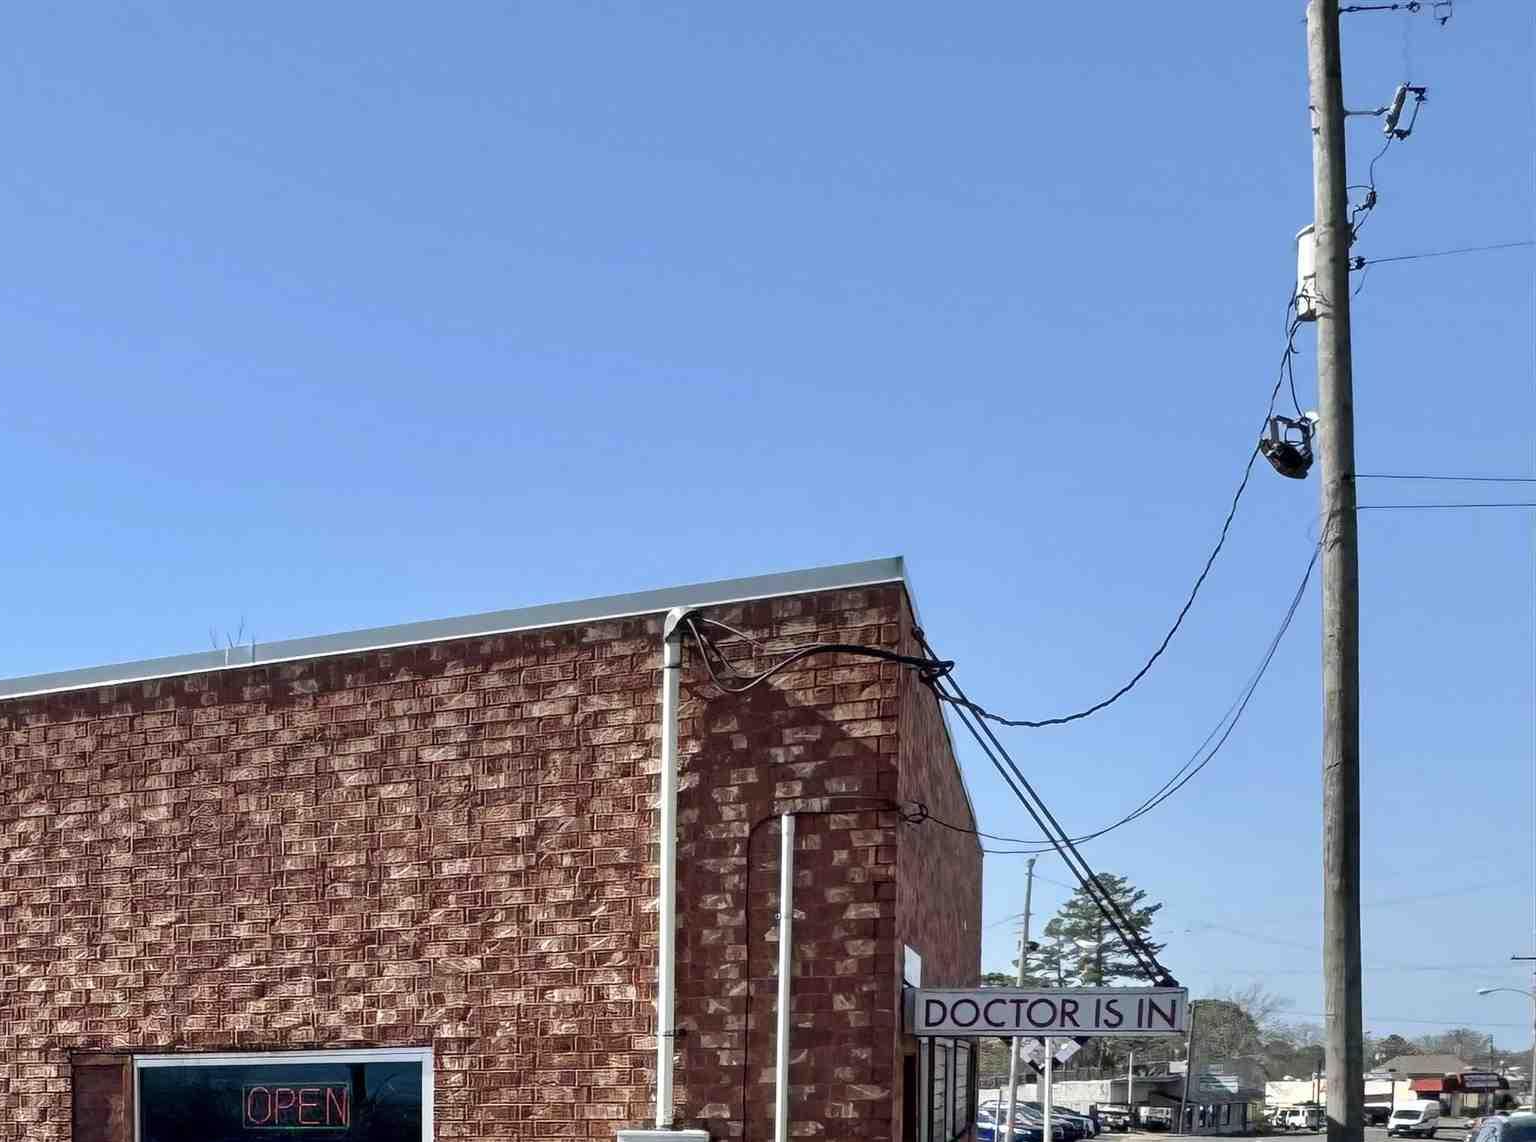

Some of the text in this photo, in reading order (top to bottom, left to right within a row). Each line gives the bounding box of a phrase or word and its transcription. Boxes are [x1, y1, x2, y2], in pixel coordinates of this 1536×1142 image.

[924, 998, 1177, 1028] DOCTOR IS IN
[247, 1086, 347, 1125] OPEN
